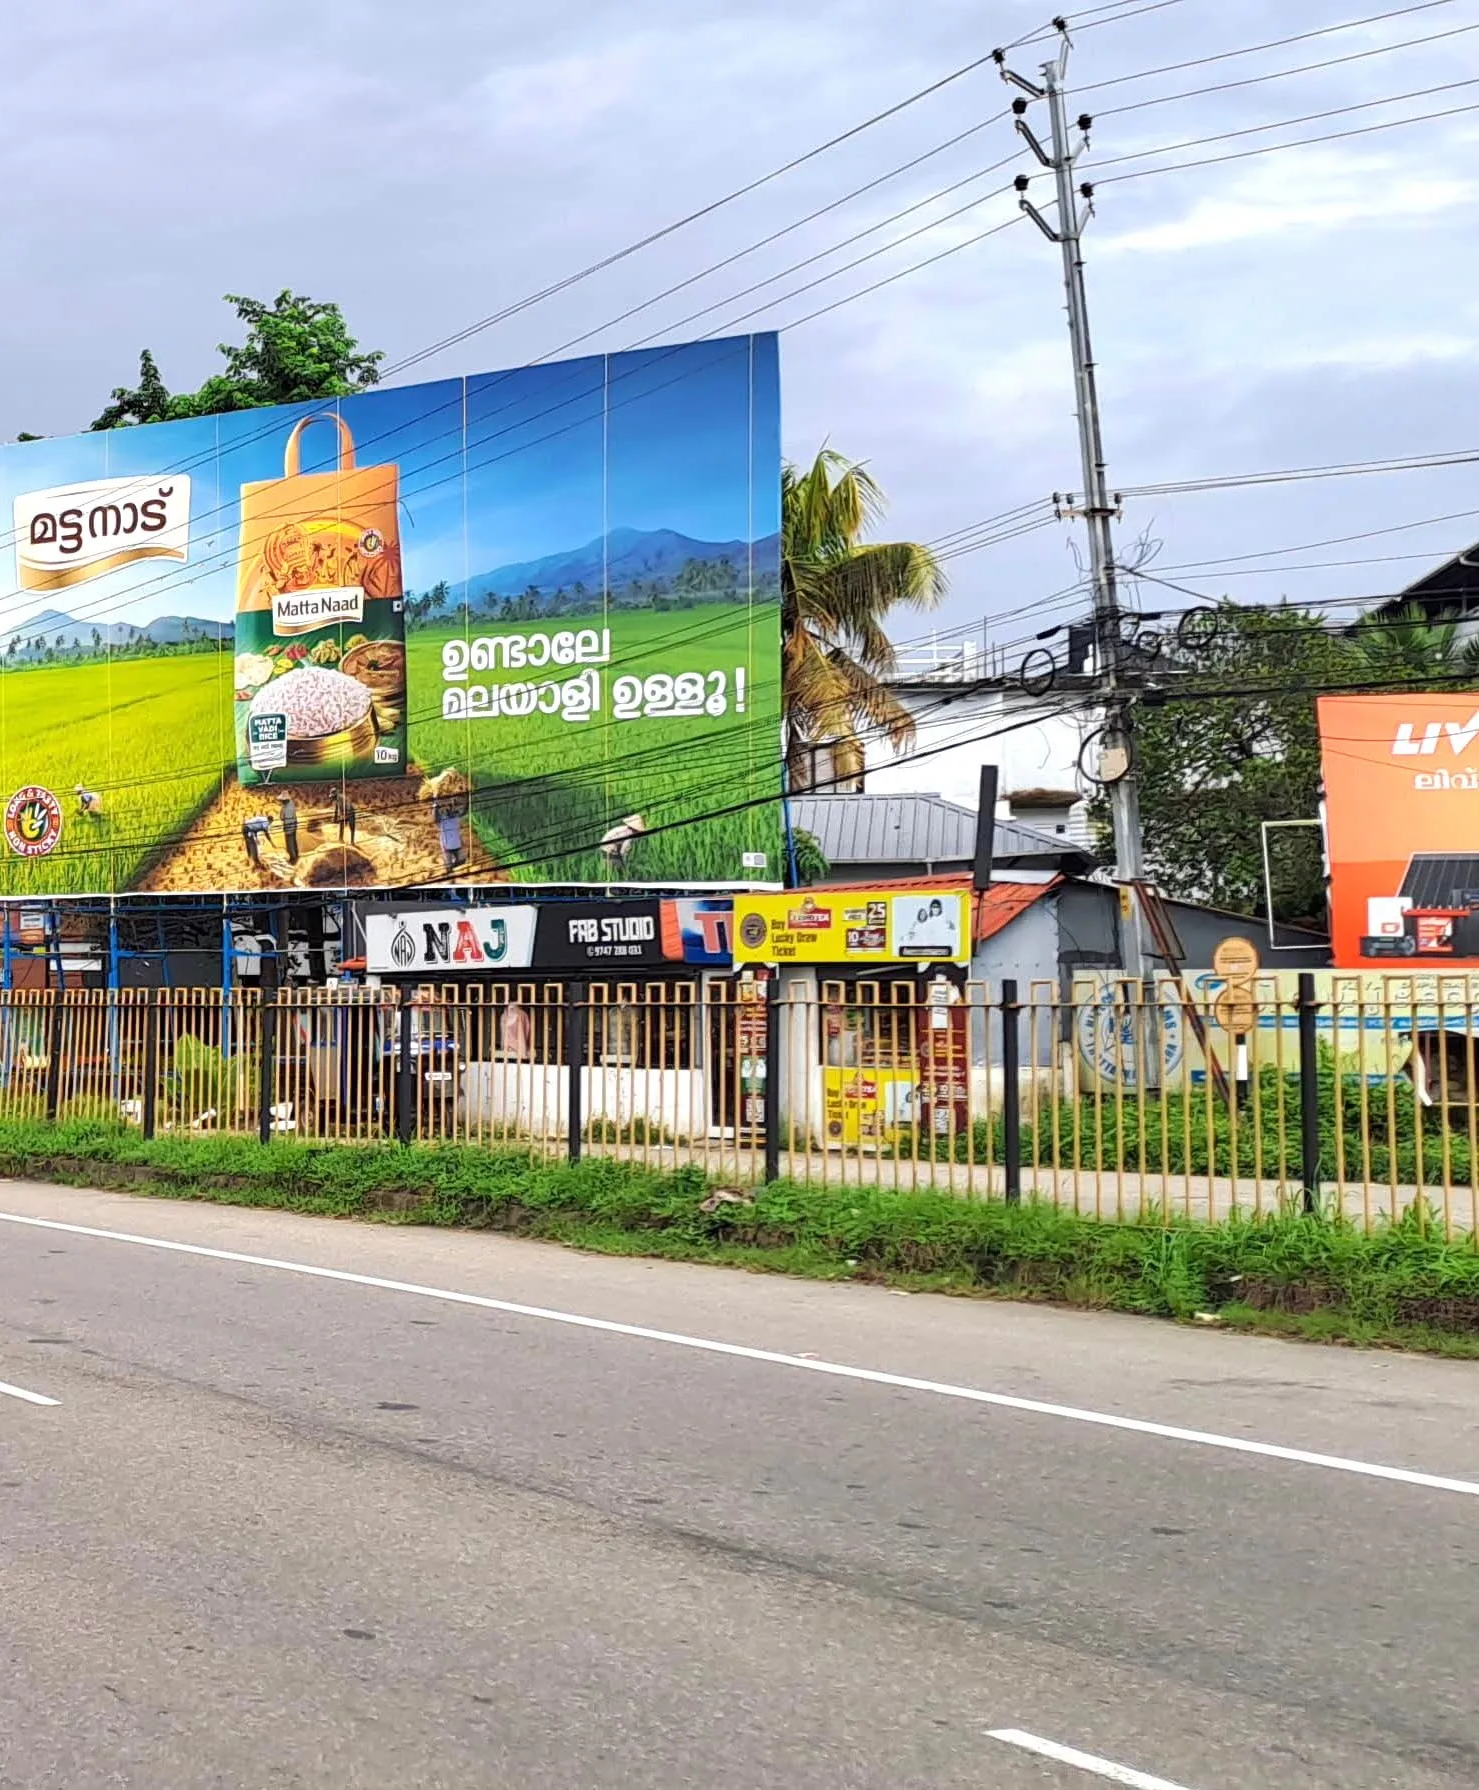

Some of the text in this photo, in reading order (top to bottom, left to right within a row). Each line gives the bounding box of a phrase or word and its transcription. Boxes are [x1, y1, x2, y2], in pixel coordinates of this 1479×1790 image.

[277, 595, 359, 618] Matta Naad
[442, 667, 601, 721] മലയാളി
[376, 750, 387, 760] 10
[8, 828, 57, 855] NON STICKY
[868, 903, 886, 918] 25
[569, 915, 655, 943] FAB STUDIO
[771, 920, 786, 931] Buy
[423, 919, 509, 965] NAJ
[771, 932, 818, 944] Lucky Draw
[848, 931, 859, 943] 10
[772, 946, 796, 957] Ticket
